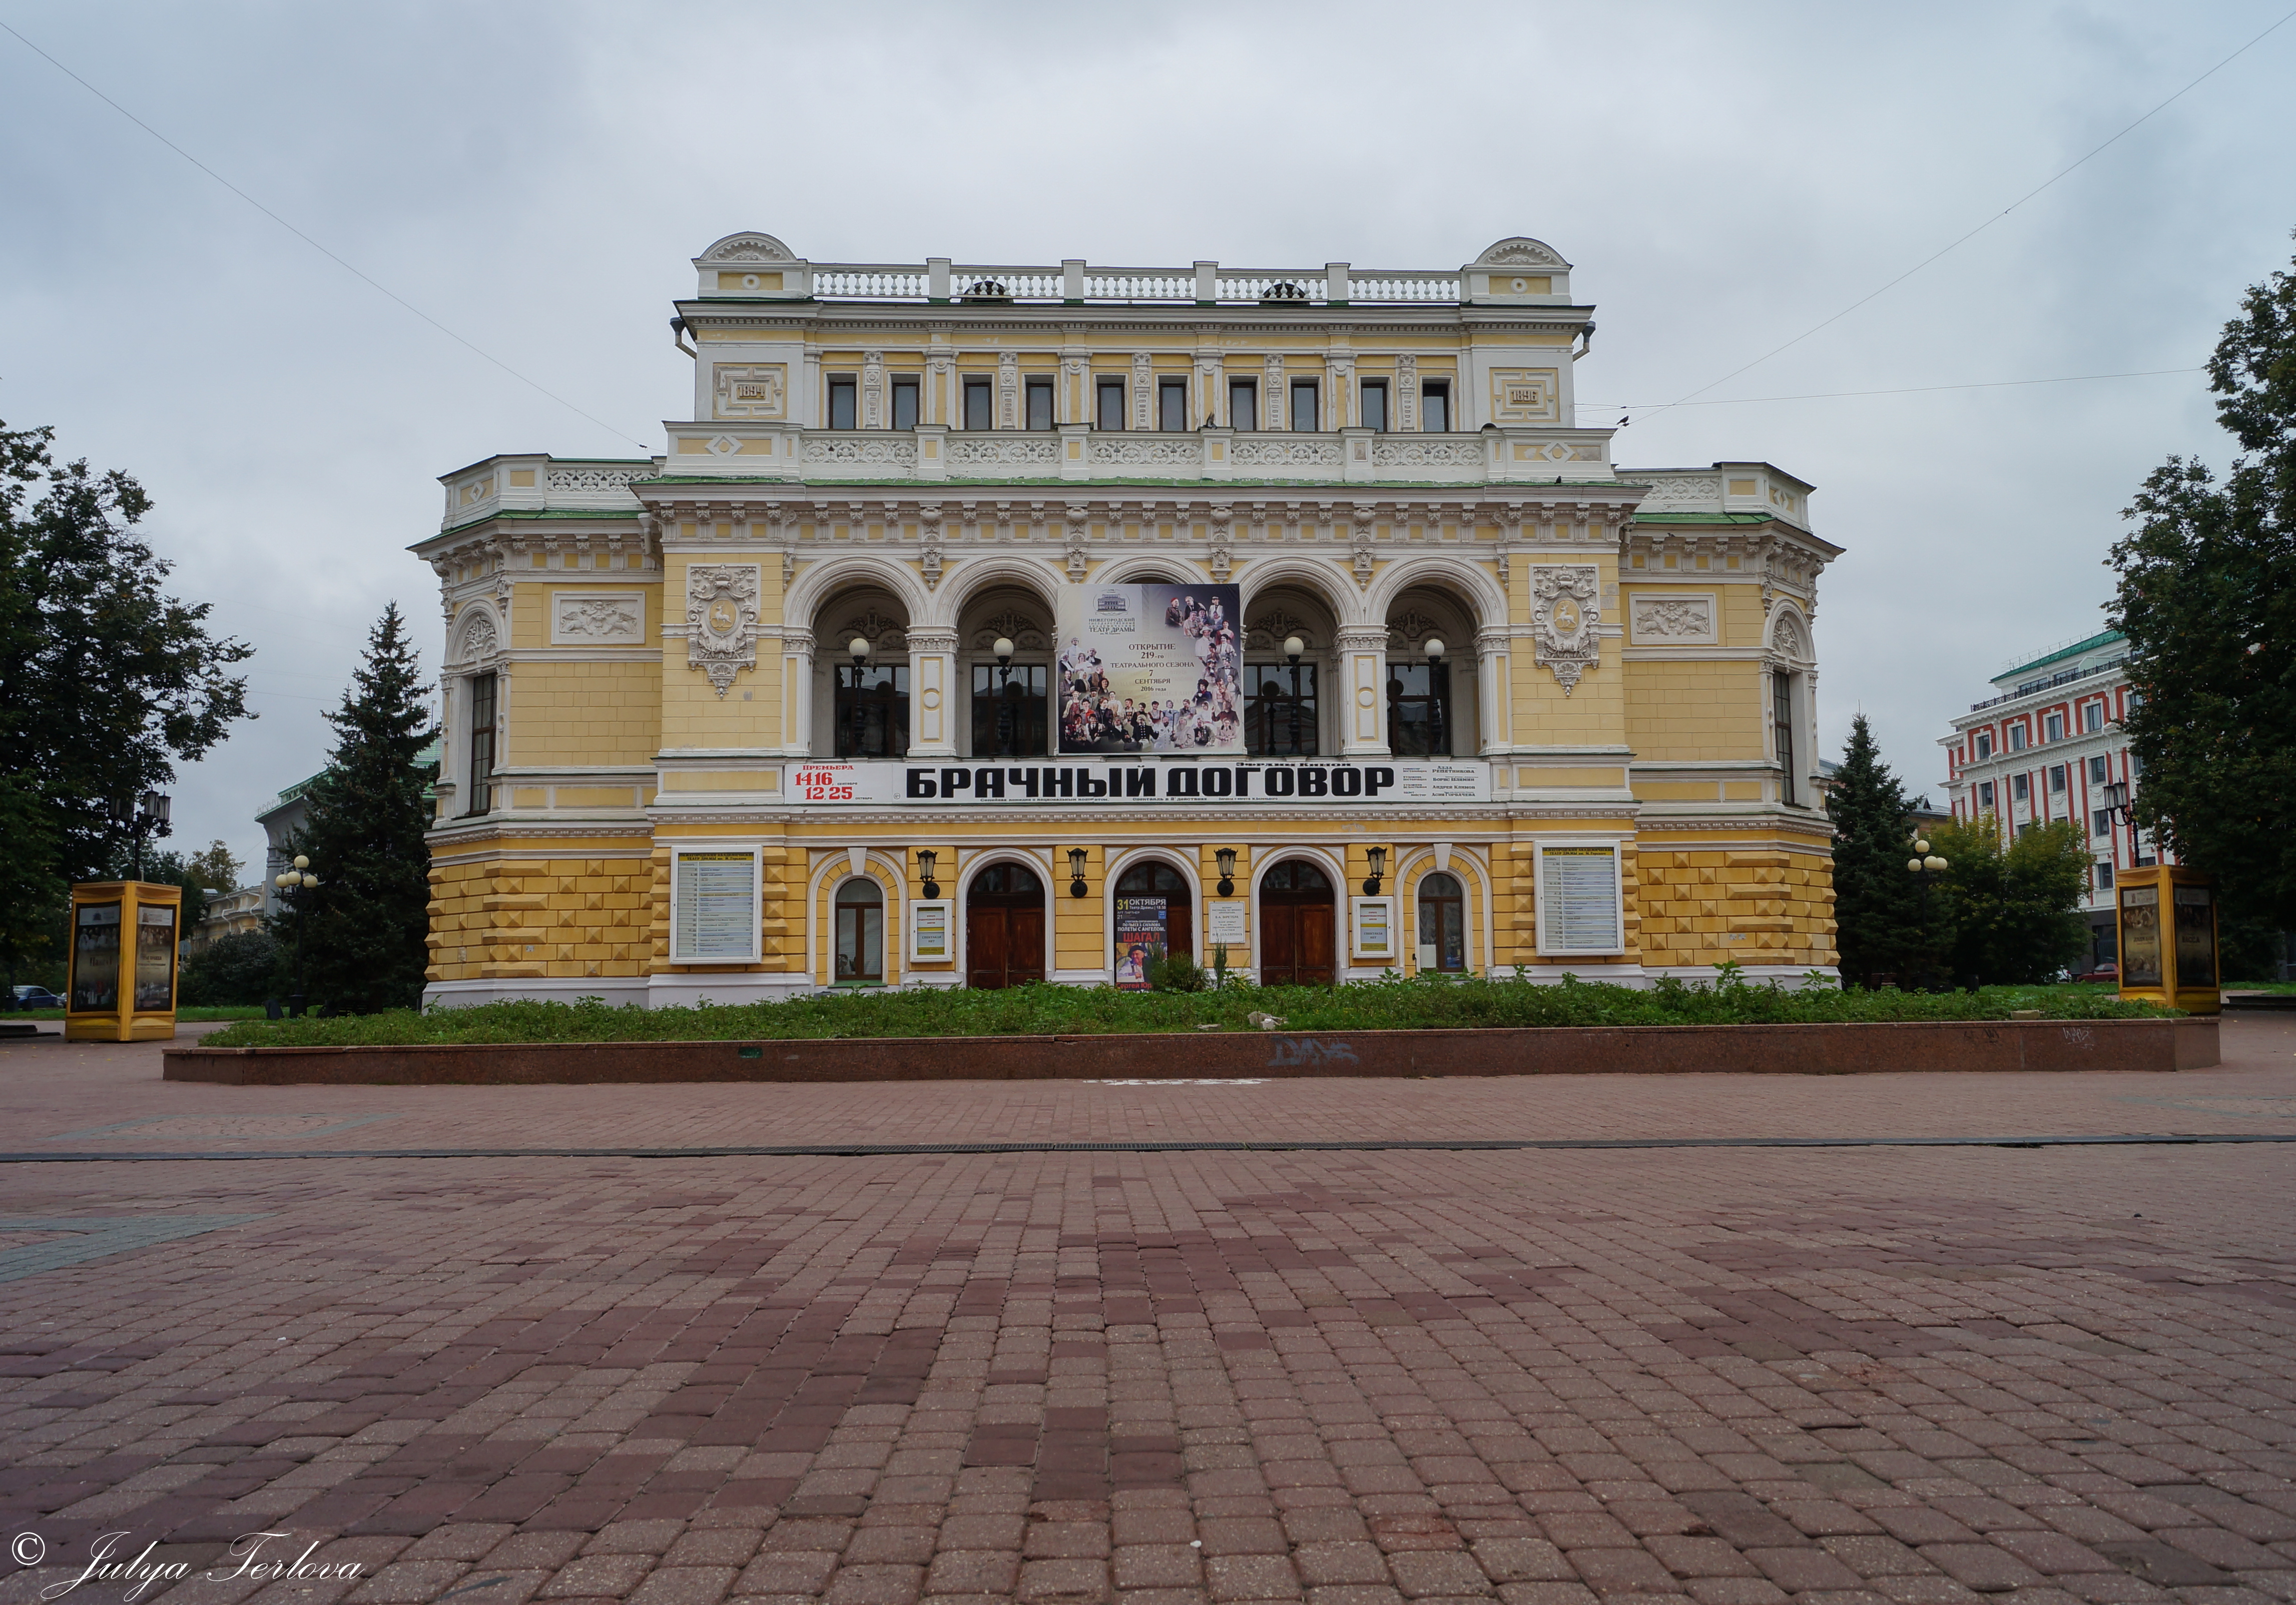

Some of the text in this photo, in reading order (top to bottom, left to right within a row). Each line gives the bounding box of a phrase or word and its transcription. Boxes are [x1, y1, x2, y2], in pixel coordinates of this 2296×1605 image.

[737, 385, 765, 397] 1894
[1511, 390, 1537, 401] 1896
[907, 765, 1394, 798] БРАЧНЫЙ ДОГОВОР
[1117, 899, 1129, 910] 31
[1123, 932, 1160, 942] ШАГАЛ
